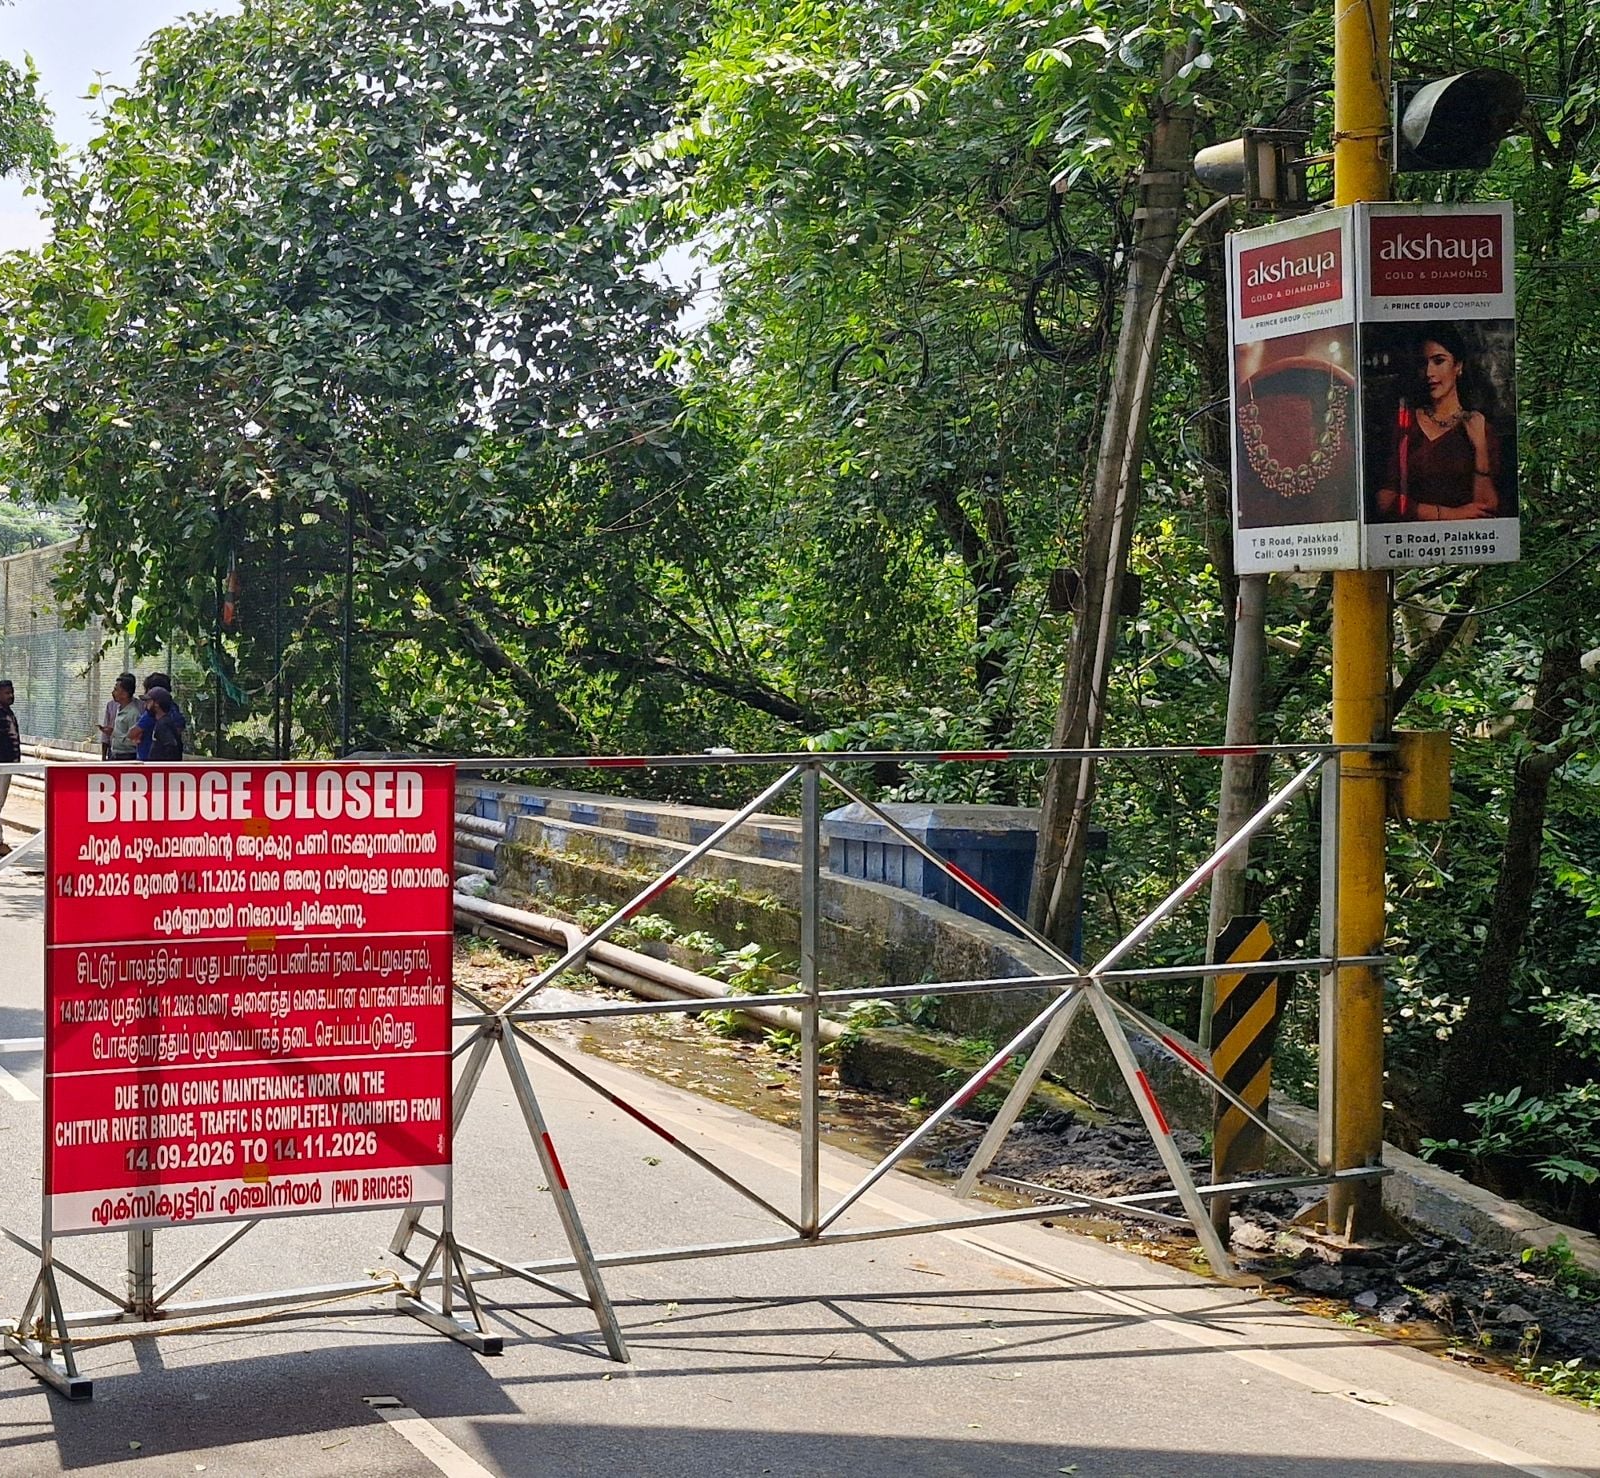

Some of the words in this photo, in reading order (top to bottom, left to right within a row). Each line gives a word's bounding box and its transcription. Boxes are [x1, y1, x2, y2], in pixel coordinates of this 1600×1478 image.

[1379, 234, 1493, 266] akshaya
[1248, 251, 1335, 288] akshaya
[1385, 271, 1414, 280] GOLD
[1419, 271, 1426, 279] &
[1431, 270, 1488, 279] DIAMONDS
[1251, 292, 1273, 304] GOLD
[1285, 280, 1331, 296] DIAMONDS
[1391, 302, 1420, 310] PRINCE
[1423, 301, 1451, 309] GROUP
[1453, 301, 1492, 309] COMPANY
[1256, 319, 1277, 328] PRINCE
[1279, 314, 1301, 324] GROUP
[1302, 308, 1333, 319] COMPANY
[1252, 538, 1258, 547] T
[1260, 537, 1266, 546] B
[1269, 536, 1294, 547] Road,
[1297, 532, 1341, 544] Palakkad.
[1254, 549, 1275, 560] Call:
[1277, 548, 1299, 558] 0491
[1302, 545, 1339, 556] 2511999
[1384, 535, 1391, 545] T
[1395, 534, 1402, 544] B
[1407, 533, 1441, 545] Road,
[1444, 530, 1499, 542] Palakkad.
[1388, 548, 1415, 559] Call:
[1419, 546, 1446, 557] 0491
[1449, 544, 1496, 555] 2511999
[87, 770, 252, 823] BRIDGE
[263, 770, 423, 820] CLOSED
[78, 835, 120, 866] ചിറ്റൂർ
[236, 834, 292, 861] അറ്റകുറ്റ
[296, 830, 328, 855] പണി
[331, 829, 436, 858] നടക്കുന്നതിനാൽ
[56, 873, 130, 897] 14.09.2026
[133, 870, 178, 899] മുതൽ
[180, 870, 246, 892] 14.11.2026
[250, 870, 280, 892] വരെ
[284, 869, 320, 894] അതു
[324, 865, 388, 894] വഴിയുള്ള
[391, 867, 450, 888] ഗതാഗതം
[154, 903, 233, 935] പൂർണ്ണമായി
[237, 900, 366, 931] നിരോധിച്ചിരിക്കുന്നു.
[119, 948, 183, 985] பாலத்தின்
[186, 954, 220, 984] பழுது
[224, 946, 278, 982] பார்க்கும்
[280, 943, 330, 974] பணிகள்
[60, 999, 108, 1023] 14.09.2026
[110, 989, 146, 1027] முதல்
[147, 995, 194, 1017] 14.11.2026
[196, 993, 229, 1020] வரை
[231, 982, 290, 1018] அனைத்து
[294, 988, 356, 1011] வகையான
[360, 976, 446, 1008] வாகனங்களின்
[92, 1024, 190, 1064] போக்குவரத்தும்
[192, 1020, 280, 1060] முழுமையாகத்
[282, 1026, 312, 1056] தடை
[316, 1013, 417, 1050] செய்யப்படுகிறது.
[115, 1085, 138, 1110] DUE
[141, 1084, 158, 1108] TO
[162, 1083, 179, 1107] ON
[182, 1079, 219, 1105] GOING
[223, 1075, 304, 1102] MAINTENANCE
[307, 1072, 340, 1097] WORK
[344, 1072, 361, 1096] ON
[364, 1070, 384, 1094] THE
[55, 1119, 108, 1147] CHITTUR
[111, 1118, 148, 1142] RIVER
[151, 1115, 197, 1142] BRIDGE,
[201, 1111, 248, 1136] TRAFFIC
[251, 1110, 262, 1133] IS
[265, 1104, 338, 1132] COMPLETELY
[342, 1101, 407, 1126] PROHIBITED
[411, 1098, 441, 1122] FROM
[126, 1140, 234, 1171] 14.09.2026
[241, 1138, 268, 1164] TO
[273, 1132, 377, 1161] 14.11.2026
[220, 1178, 322, 1214] എഞ്ചിനീയർ
[332, 1179, 358, 1208] (PWD
[362, 1174, 412, 1204] BRIDGES)
